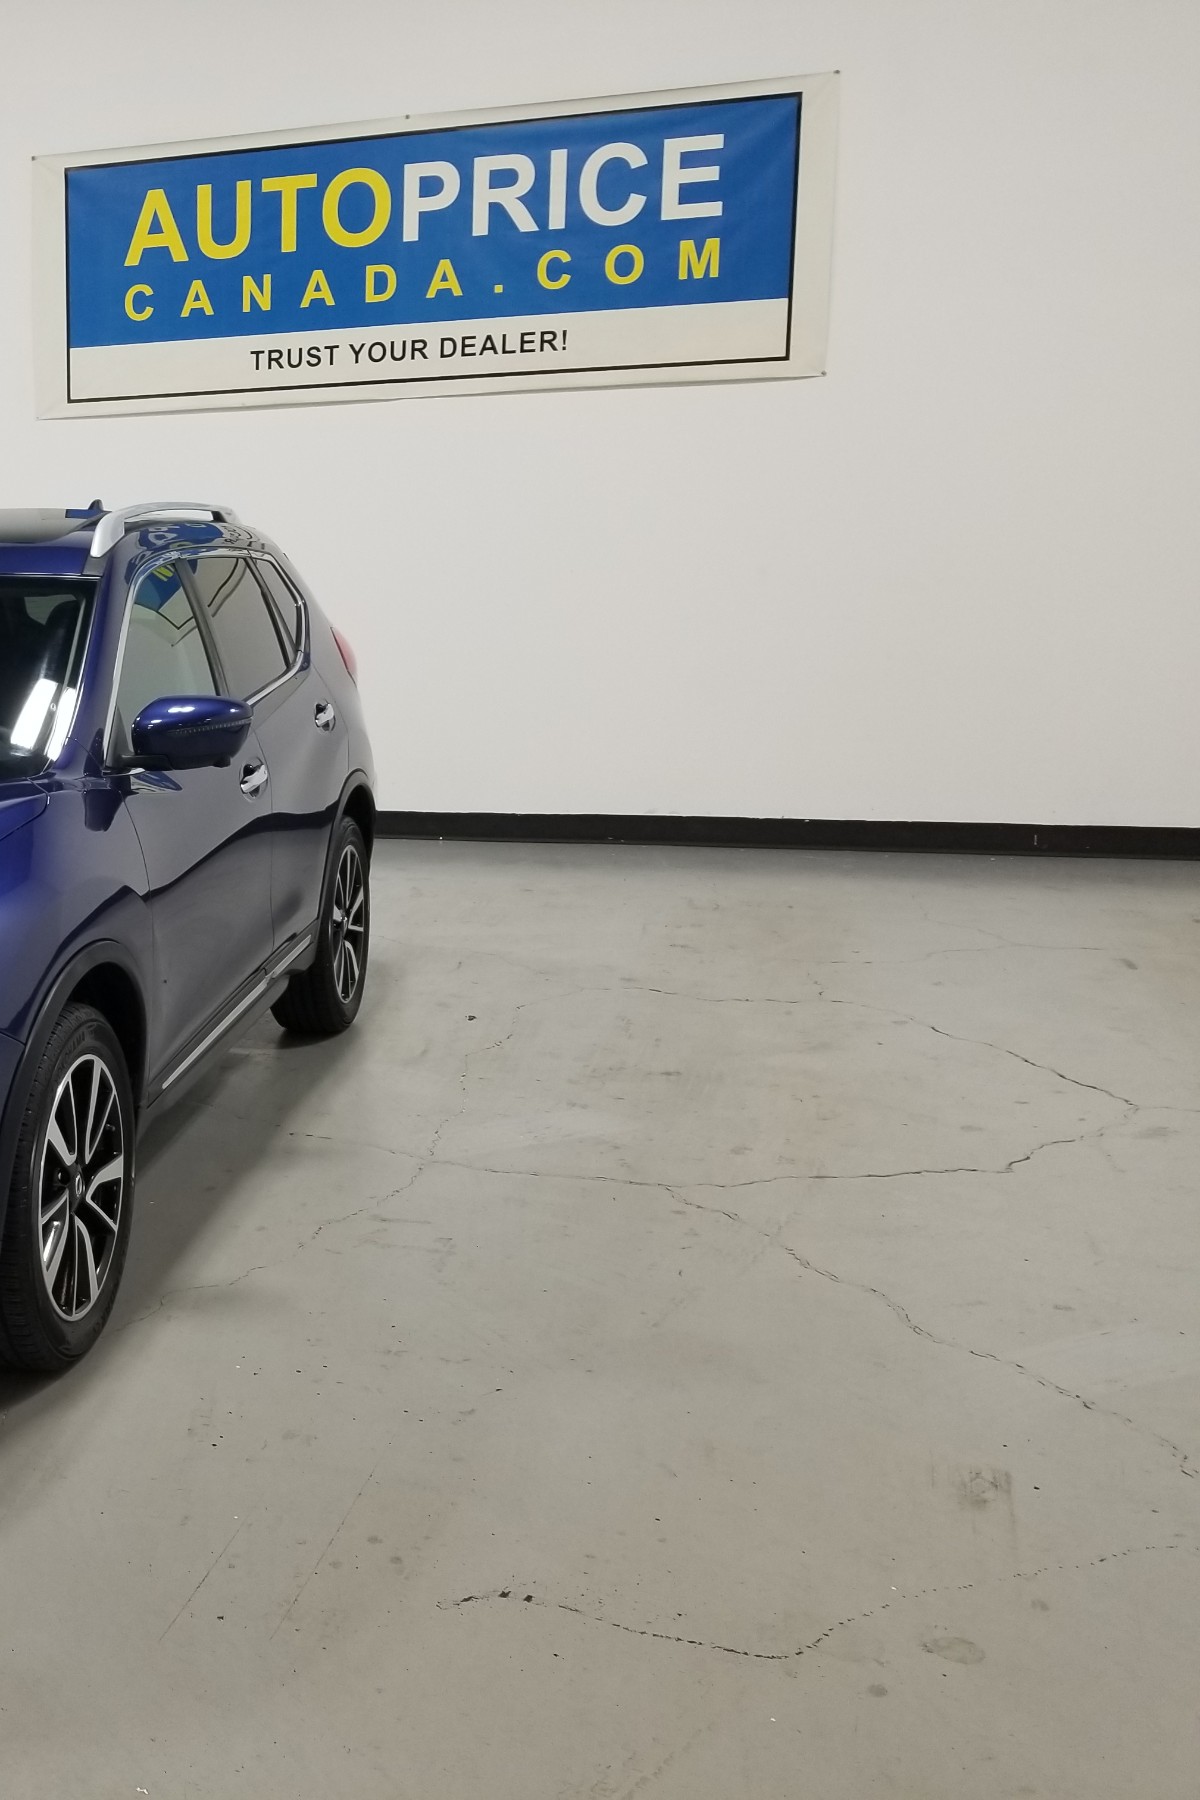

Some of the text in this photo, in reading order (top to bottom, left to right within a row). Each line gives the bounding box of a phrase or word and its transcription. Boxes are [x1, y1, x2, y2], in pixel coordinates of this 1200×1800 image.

[123, 133, 725, 267] AUTOPRICE
[123, 237, 721, 322] CANADA.COM
[250, 329, 568, 371] TRUST YOUR DEALER!
